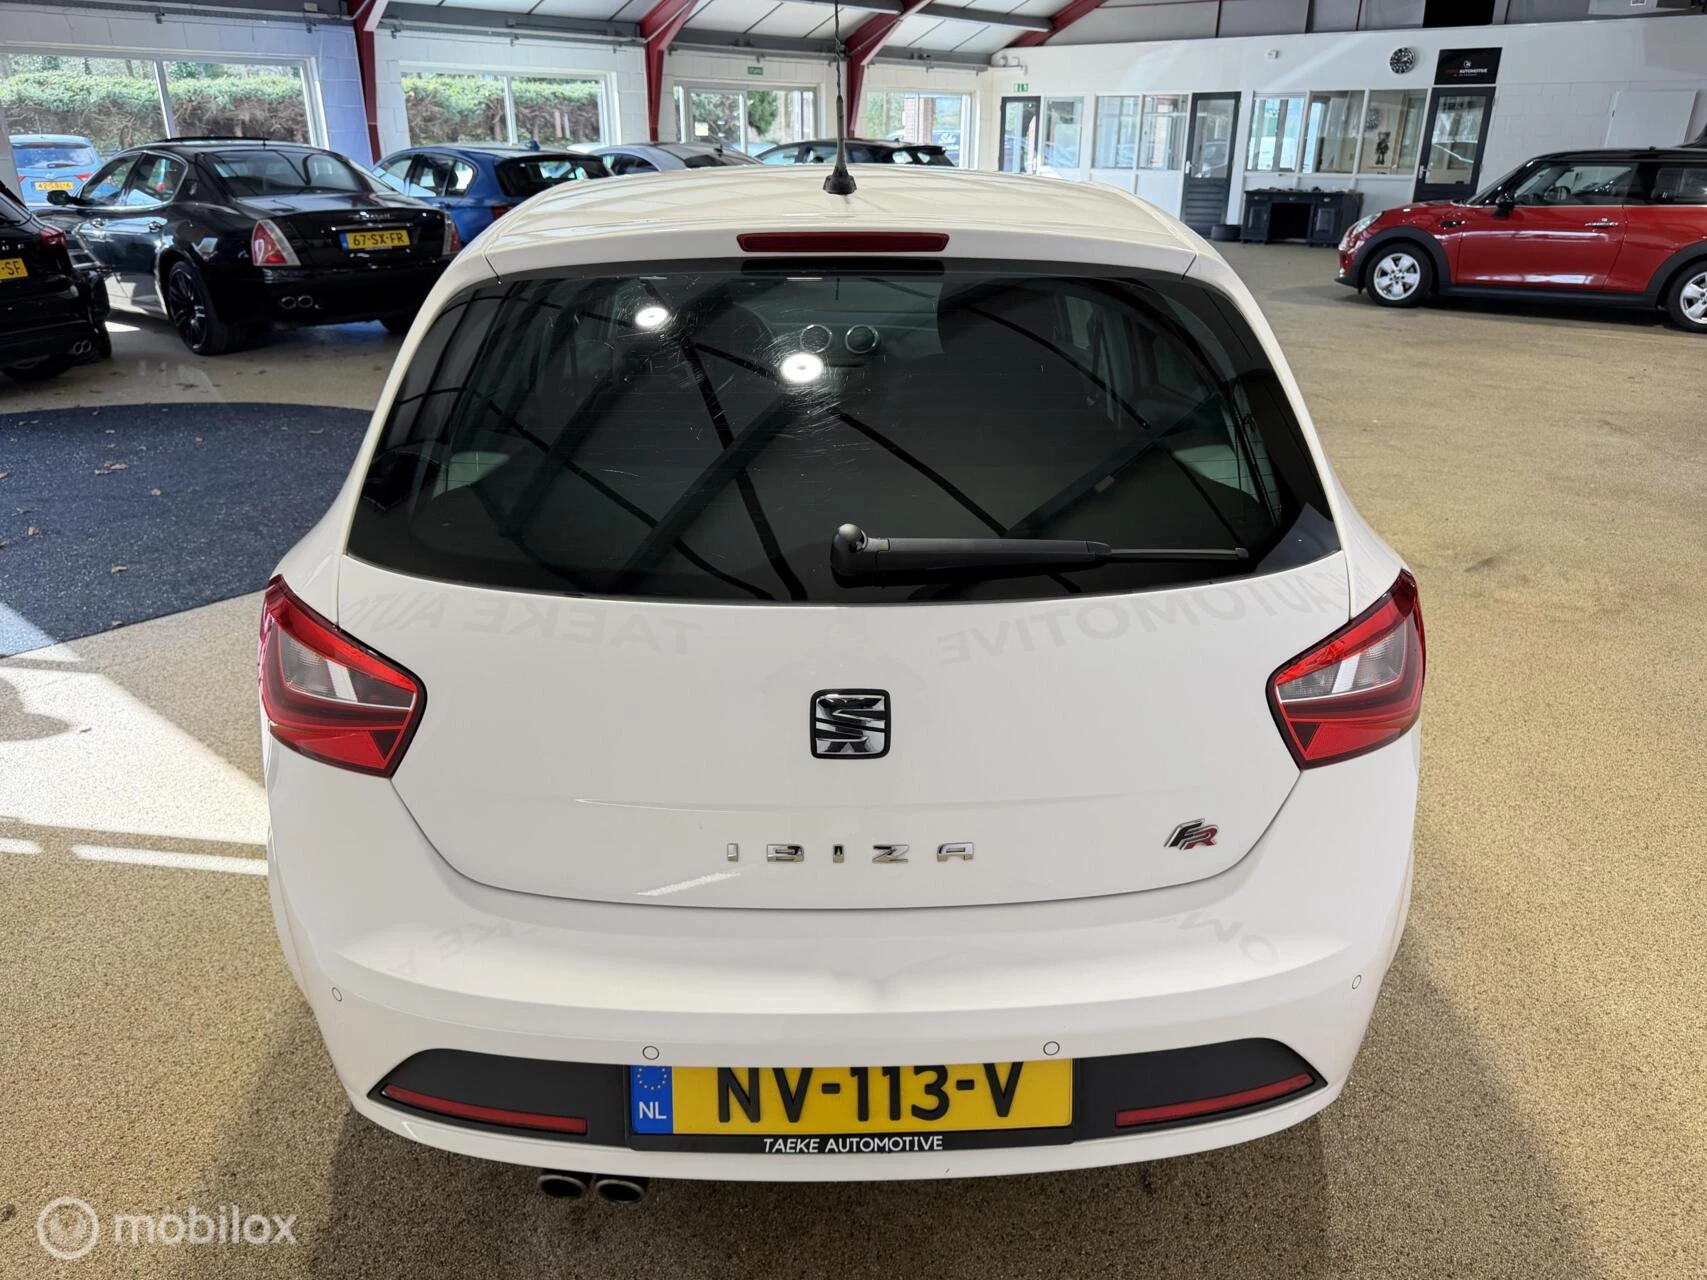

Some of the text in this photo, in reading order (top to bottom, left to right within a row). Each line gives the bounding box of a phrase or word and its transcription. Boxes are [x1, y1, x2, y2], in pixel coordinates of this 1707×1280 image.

[353, 233, 404, 246] 67-SX-FR
[0, 260, 20, 275] -SF
[727, 841, 975, 863] IBIZA
[717, 1061, 1024, 1123] NV-113-V
[638, 1101, 667, 1120] NL
[763, 1136, 943, 1153] TAEKE AUTOMOTIVE
